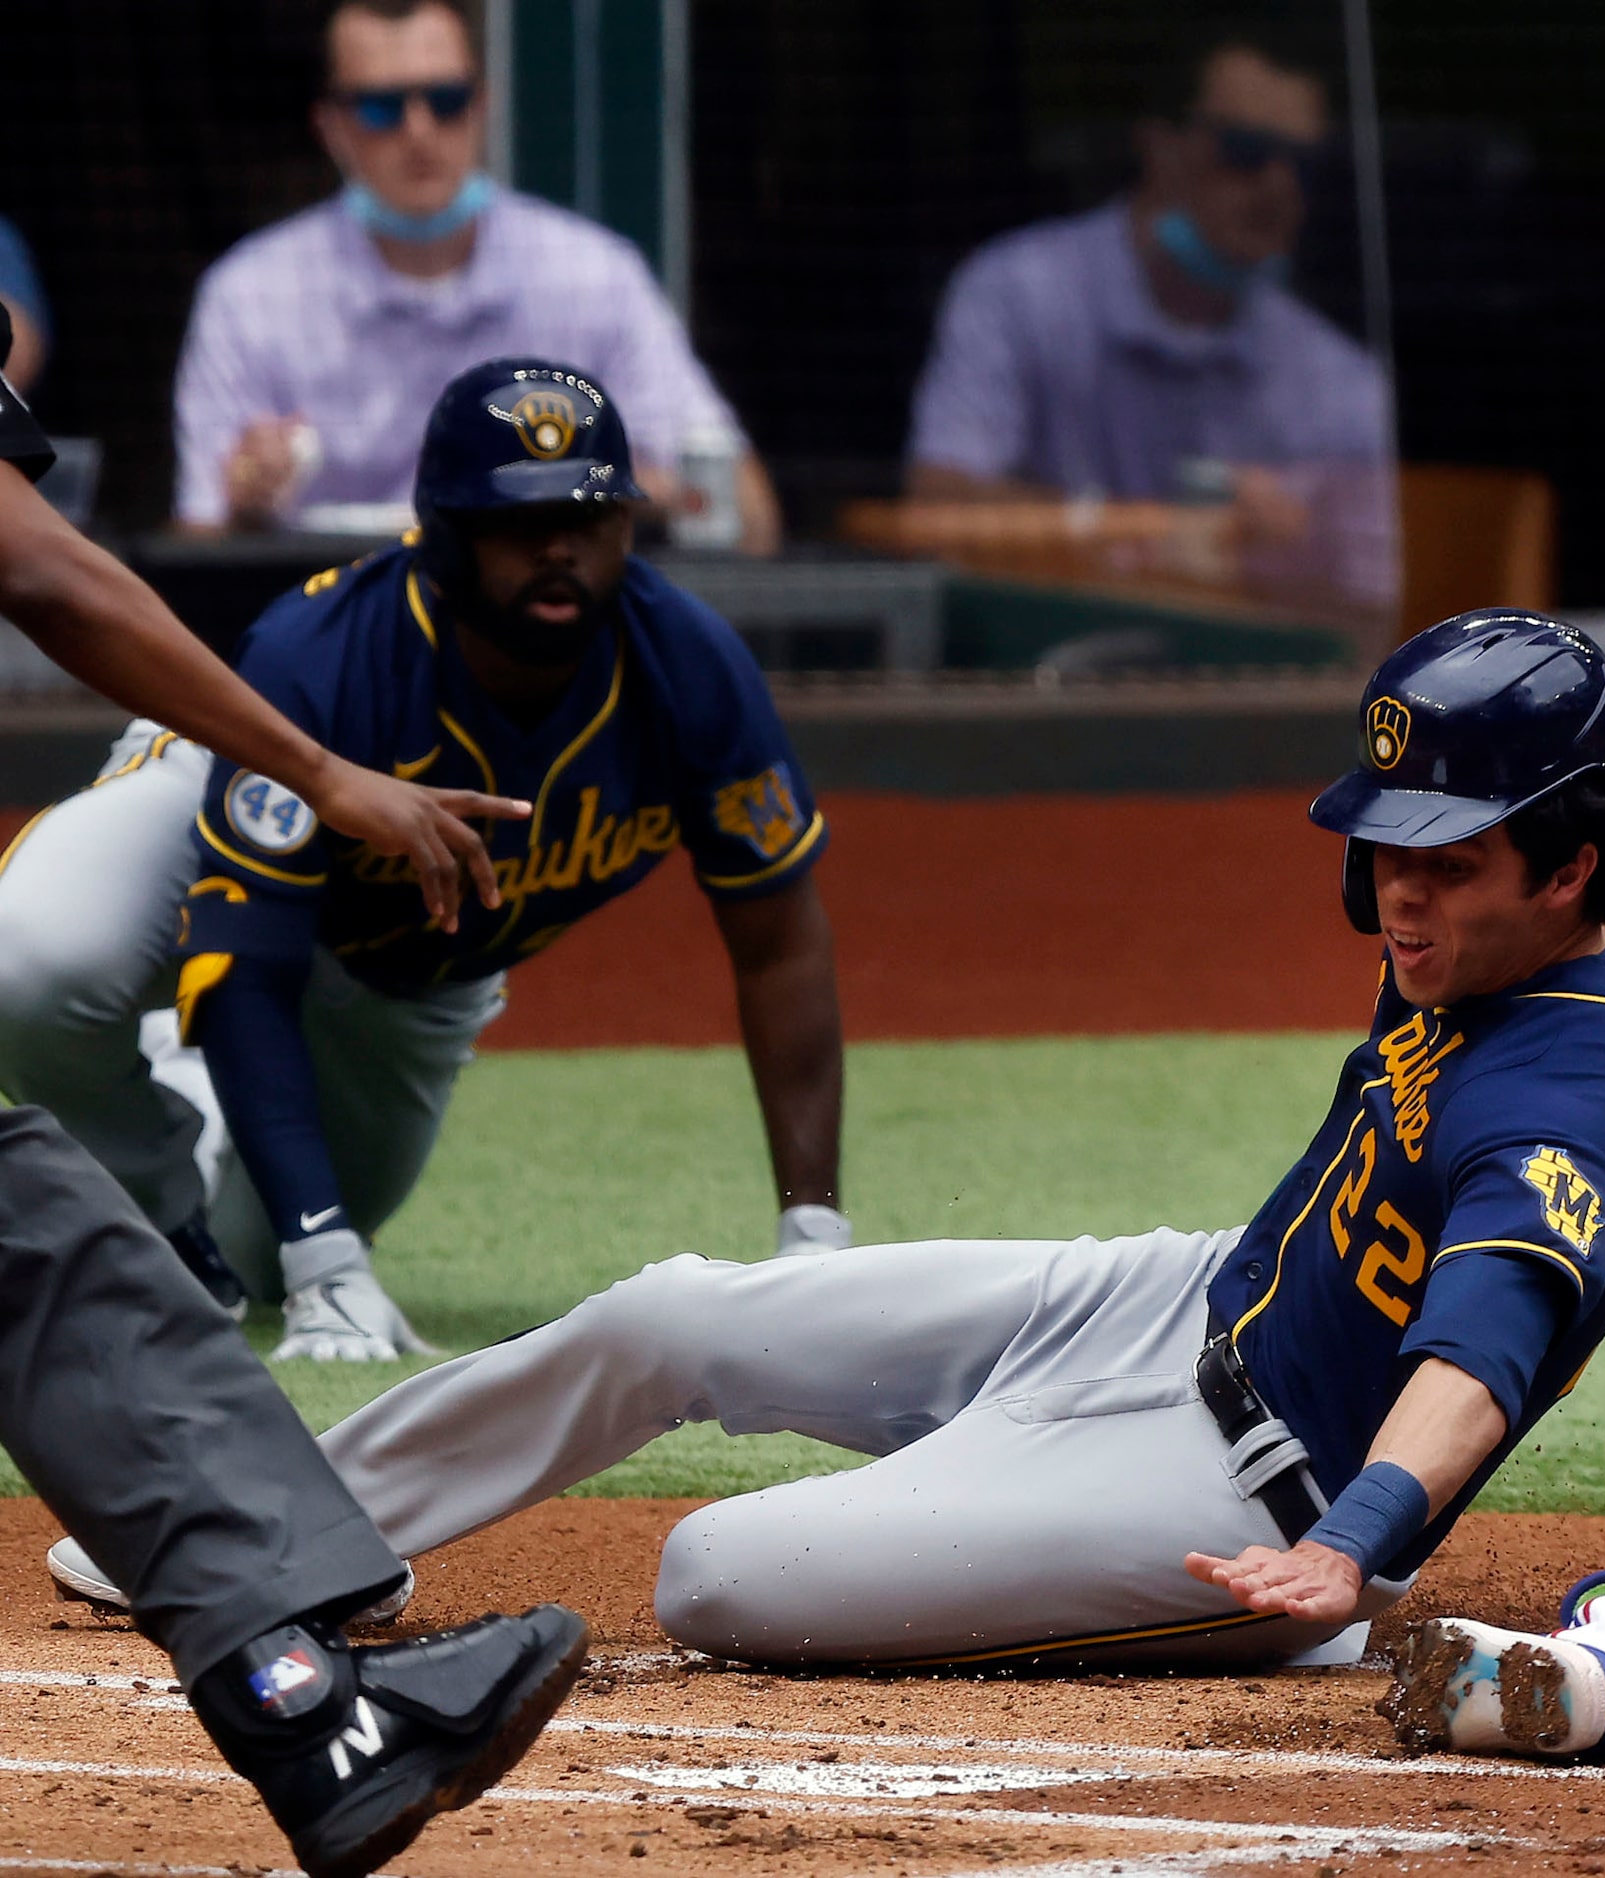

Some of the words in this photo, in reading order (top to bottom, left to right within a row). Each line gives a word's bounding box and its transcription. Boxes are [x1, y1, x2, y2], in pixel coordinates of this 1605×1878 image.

[241, 782, 300, 838] 44
[1329, 1127, 1427, 1328] 22
[1549, 1169, 1596, 1235] M
[328, 1695, 384, 1780] N
